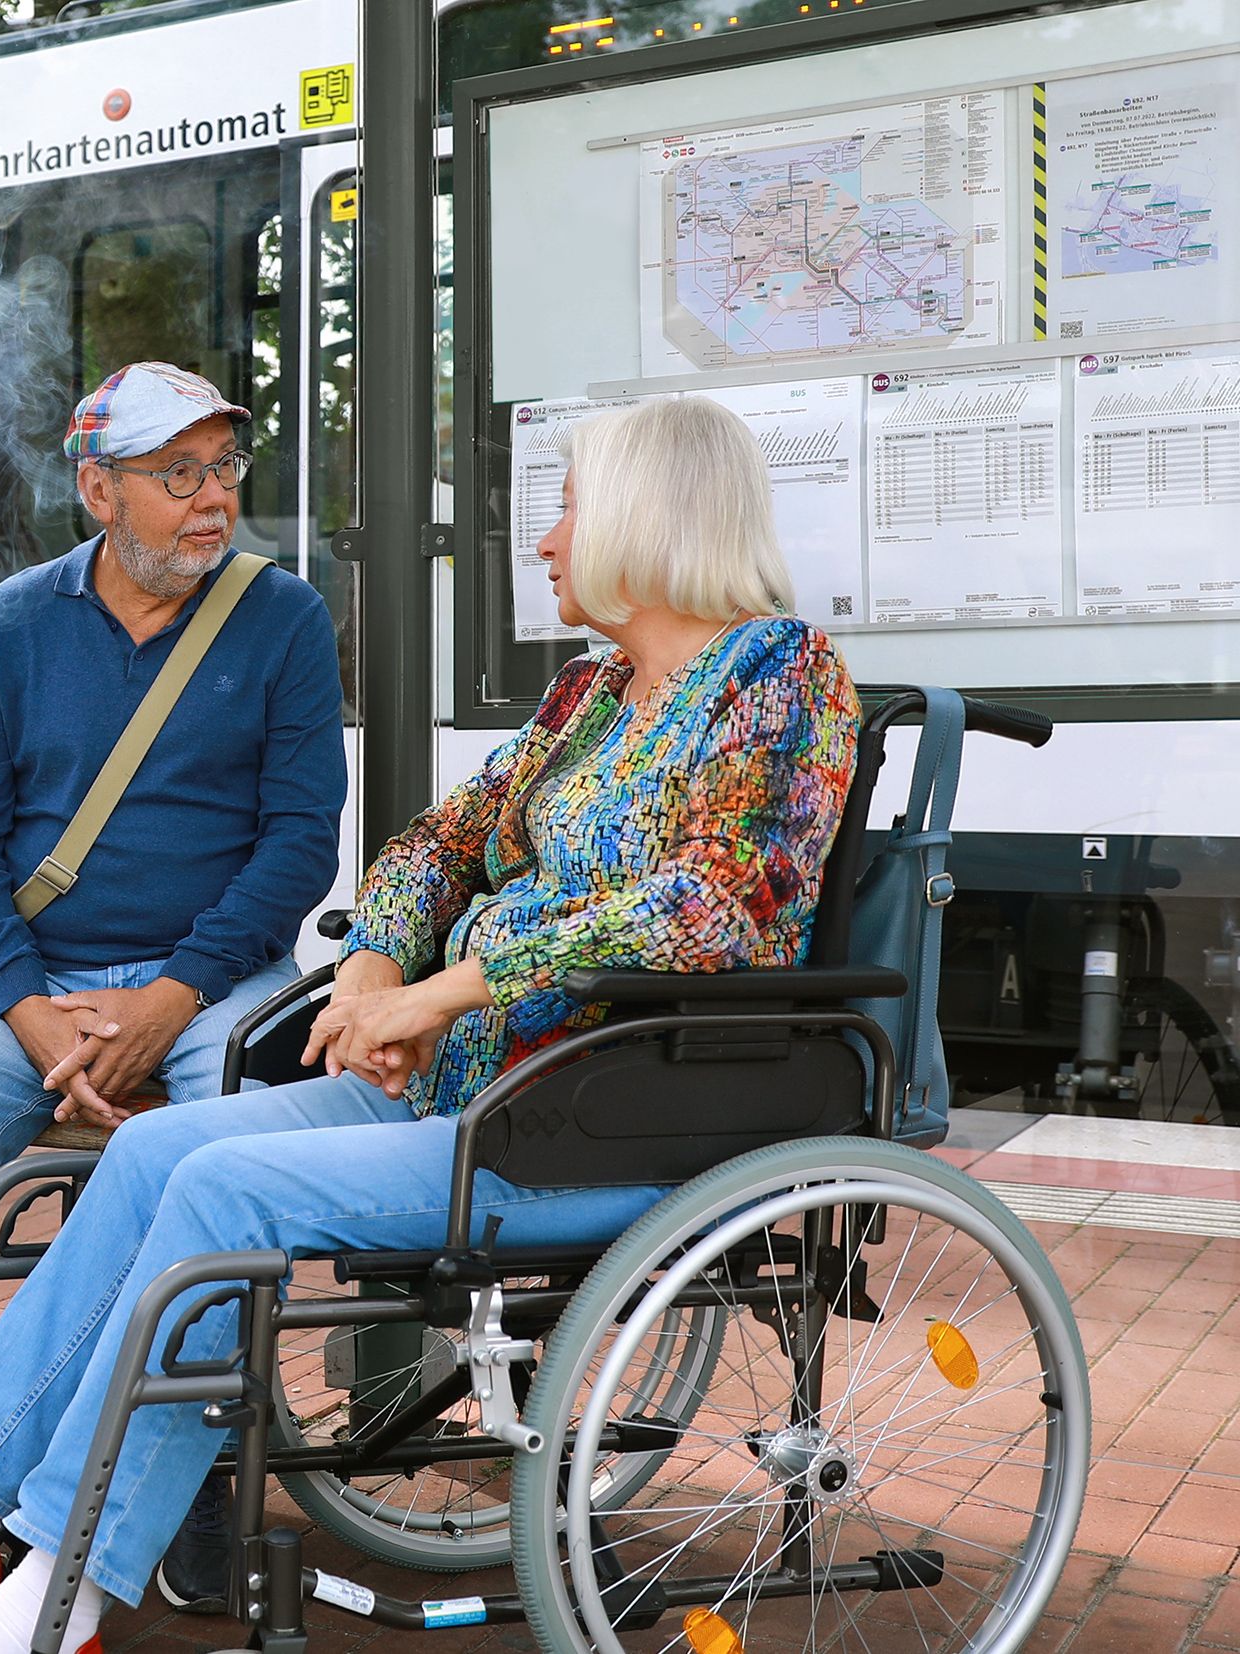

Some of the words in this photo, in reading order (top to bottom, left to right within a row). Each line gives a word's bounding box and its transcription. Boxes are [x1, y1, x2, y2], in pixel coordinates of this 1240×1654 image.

[1080, 104, 1142, 118] Straßenbauarbeiten
[1103, 354, 1120, 364] 697
[1080, 360, 1098, 369] BUS
[894, 374, 909, 382] 692
[873, 378, 890, 388] BUS
[790, 389, 806, 398] BUS
[534, 408, 546, 416] 612
[1000, 953, 1020, 999] A
